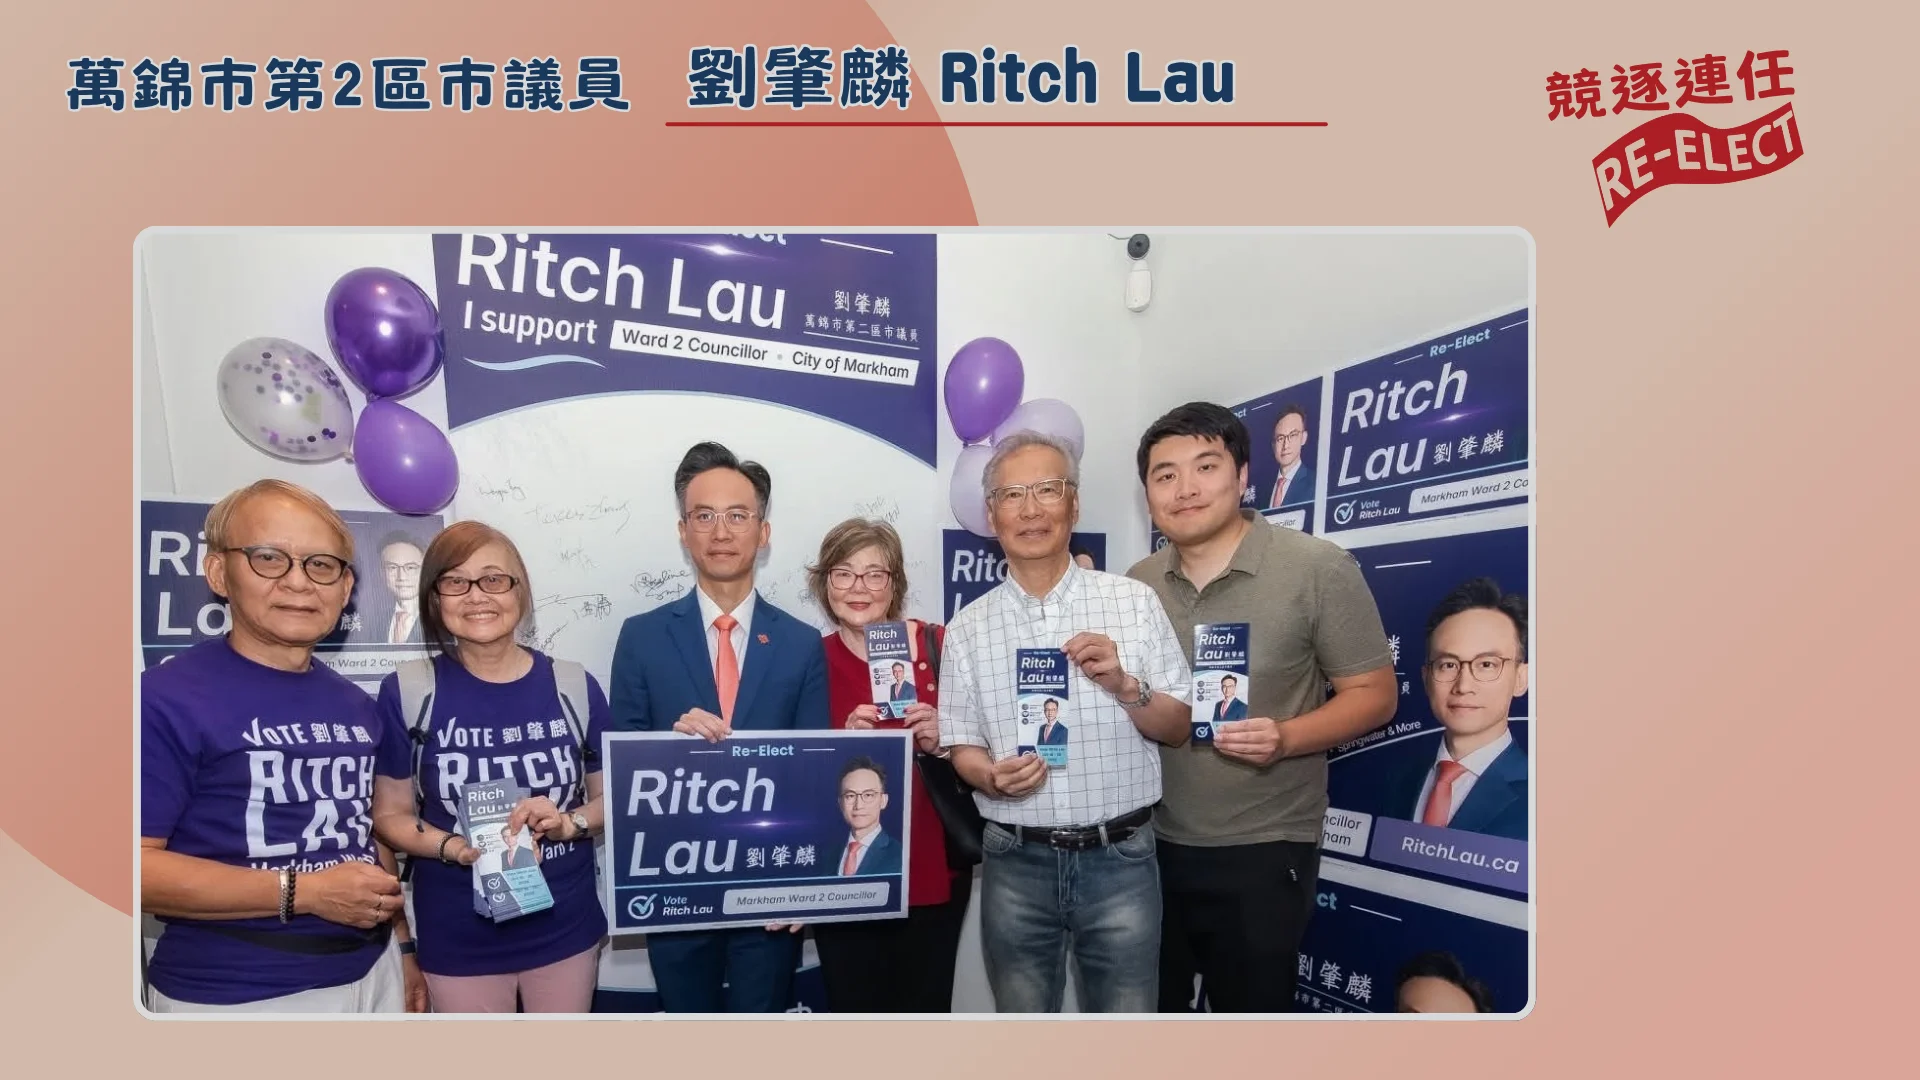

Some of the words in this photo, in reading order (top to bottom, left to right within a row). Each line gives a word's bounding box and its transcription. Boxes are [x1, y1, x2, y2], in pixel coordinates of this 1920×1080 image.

[457, 234, 645, 309] Ritch
[667, 258, 787, 330] Lau
[834, 289, 890, 318] 劉肇麟
[464, 300, 473, 329] I
[480, 309, 598, 345] support
[804, 313, 919, 342] 萬錦市第二區市議員
[1429, 328, 1491, 358] Re-Elect
[621, 327, 669, 349] Ward
[672, 334, 684, 350] 2
[688, 336, 768, 361] Councillor
[792, 350, 822, 370] City
[825, 356, 841, 373] of
[843, 357, 910, 379] Markham
[1341, 361, 1469, 434] Ritch
[1337, 438, 1428, 487] Lau
[1433, 429, 1504, 465] 劉肇麟
[1421, 489, 1468, 504] Markham
[1471, 483, 1500, 496] Ward
[1503, 480, 1510, 491] 2
[1359, 508, 1381, 519] Ritch
[1383, 506, 1401, 516] Lau
[1361, 500, 1380, 509] Vote
[952, 549, 1009, 582] Ritc
[158, 591, 234, 636] La
[869, 628, 898, 640] Ritch
[1198, 633, 1235, 645] Ritch
[868, 642, 890, 651] Lau
[1196, 648, 1222, 660] Lau
[1021, 657, 1055, 669] Ritch
[1019, 671, 1045, 683] Lau
[1395, 721, 1421, 734] More
[732, 744, 794, 757] Re-Elect
[468, 788, 505, 803] Ritch
[626, 767, 775, 816] Ritch
[468, 804, 496, 816] Lau
[1321, 814, 1362, 830] ncillor
[629, 831, 738, 877] Lau
[746, 845, 816, 868] 劉肇麟
[1401, 836, 1520, 874] RitchLau.ca
[663, 895, 687, 905] Vote
[736, 895, 785, 906] Markham
[788, 893, 816, 903] Ward
[818, 893, 824, 902] 2
[827, 890, 877, 901] Councillor
[662, 905, 690, 916] Ritch
[692, 905, 713, 914] Lau
